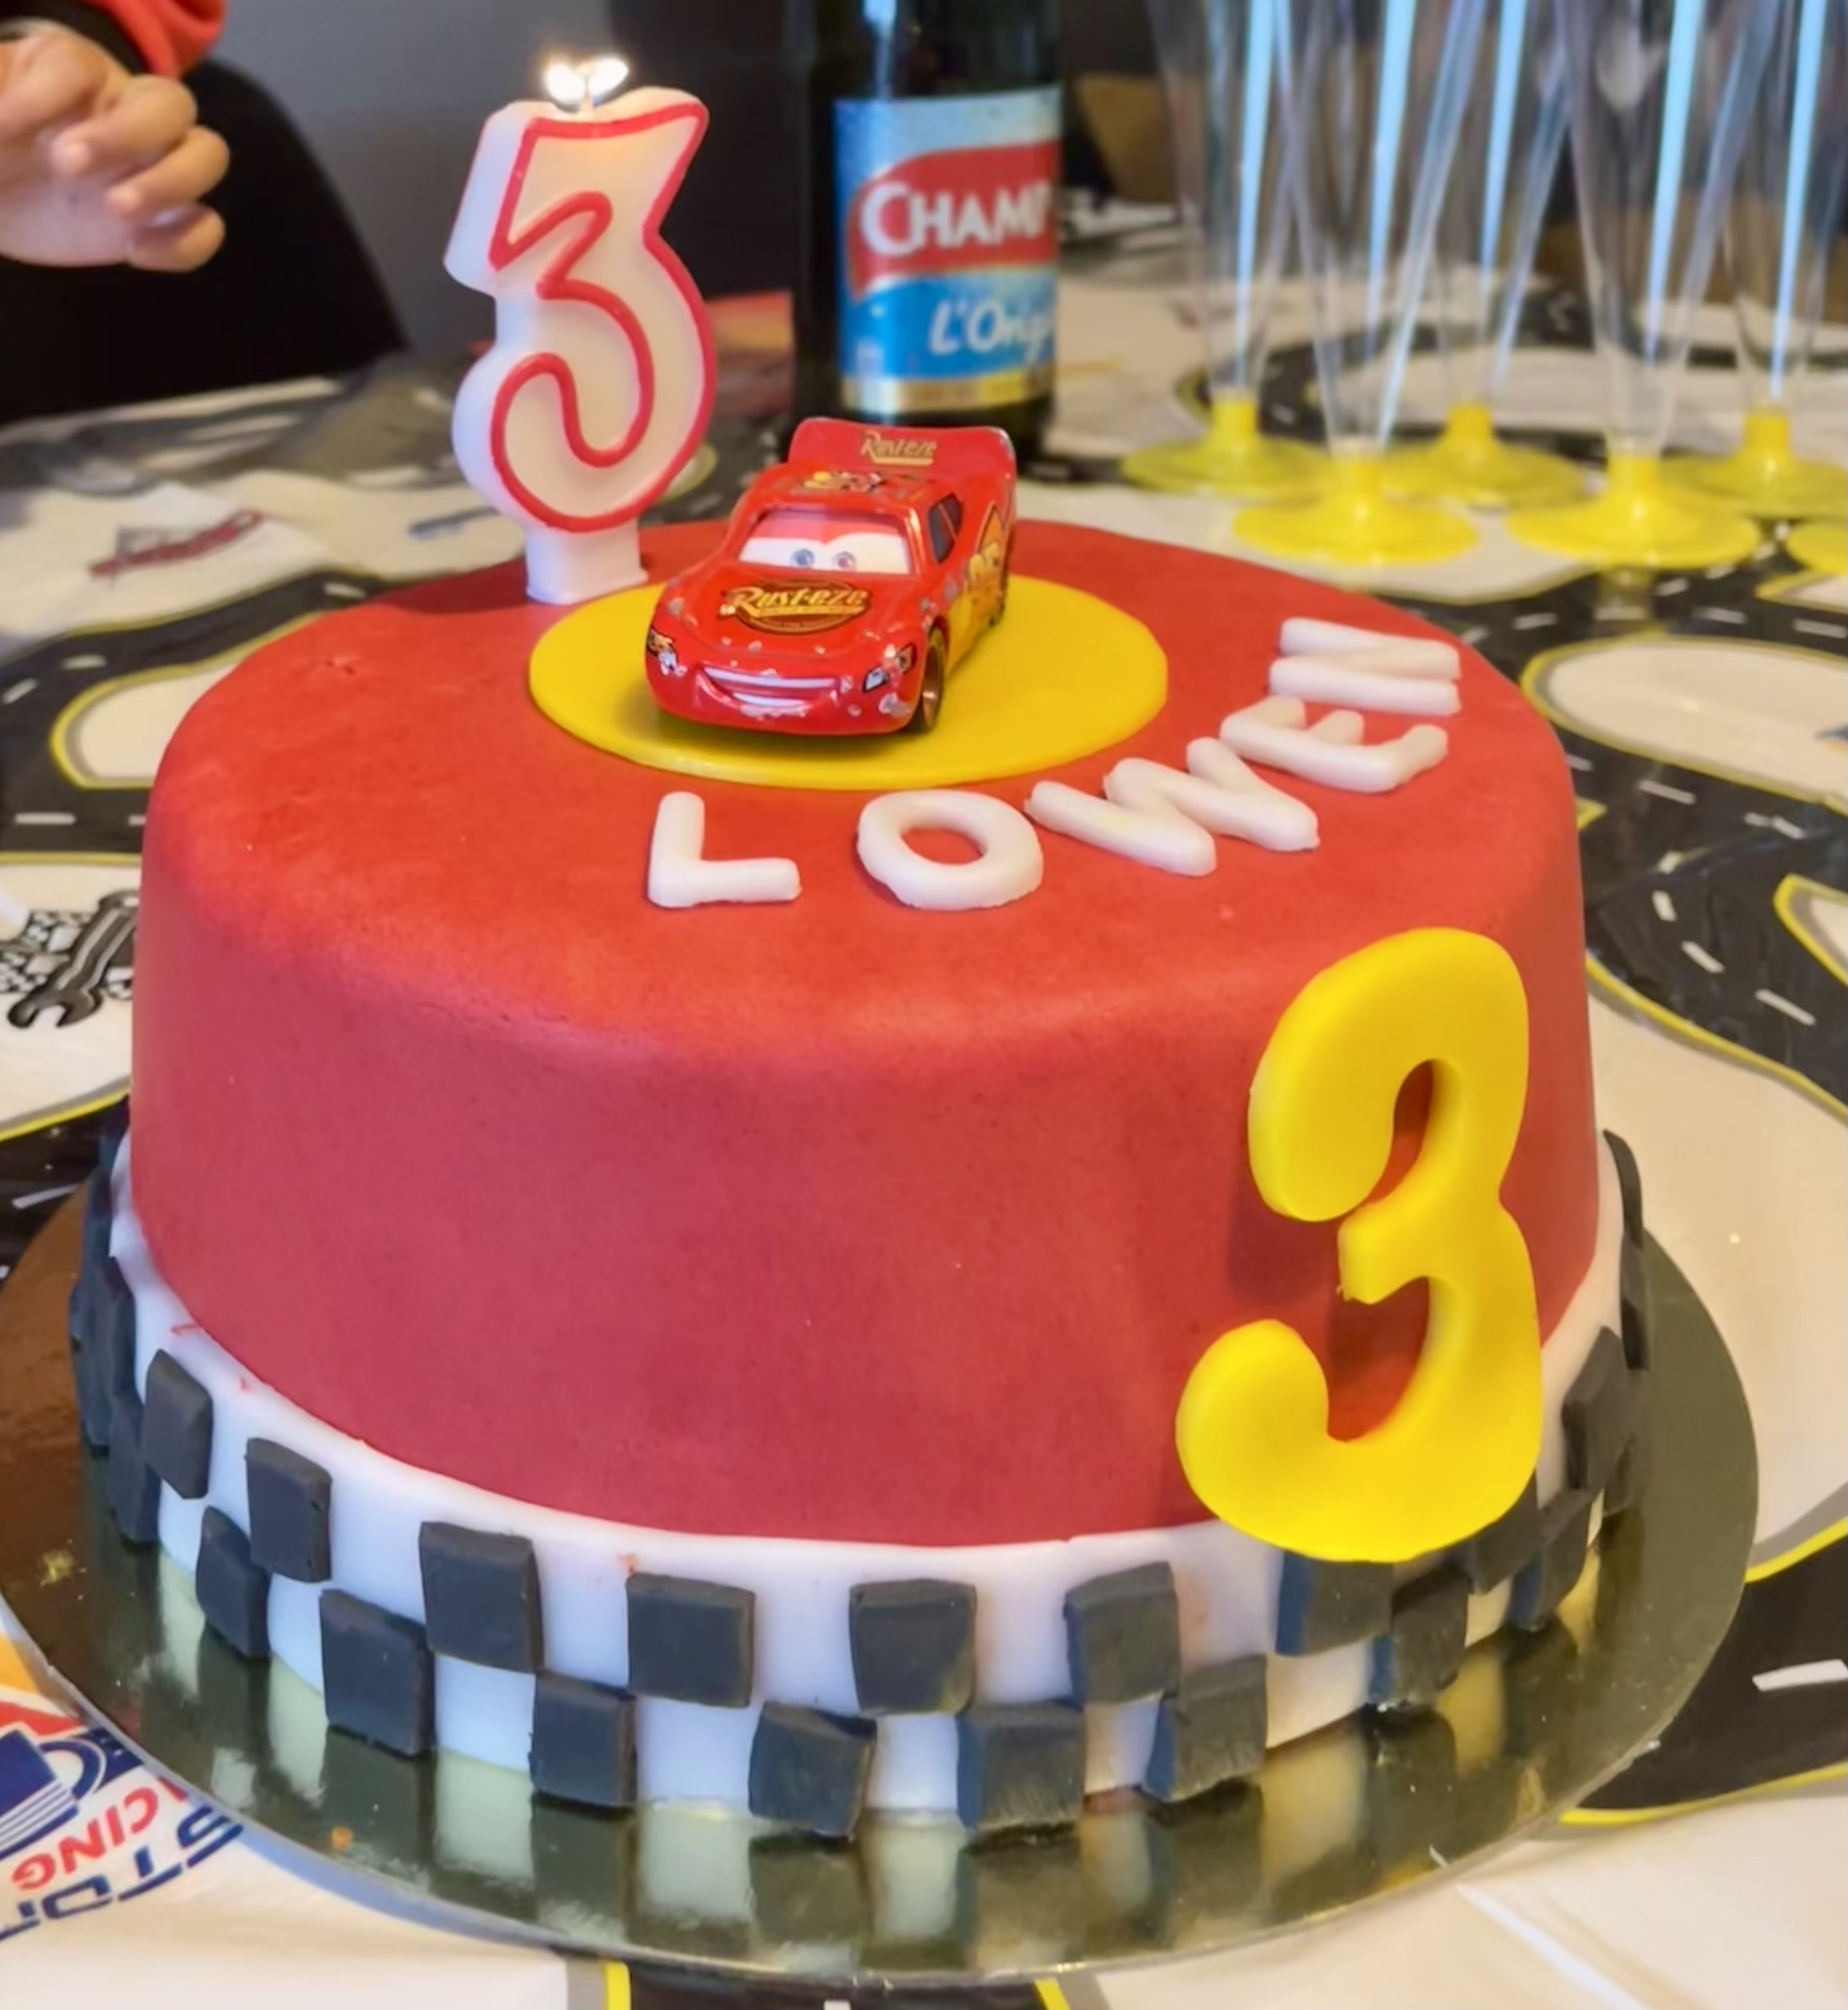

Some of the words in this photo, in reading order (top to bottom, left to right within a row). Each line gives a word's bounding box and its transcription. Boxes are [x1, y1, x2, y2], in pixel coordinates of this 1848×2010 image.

[486, 94, 717, 534] 3
[647, 617, 1462, 911] LOWEN
[1175, 926, 1544, 1563] 3
